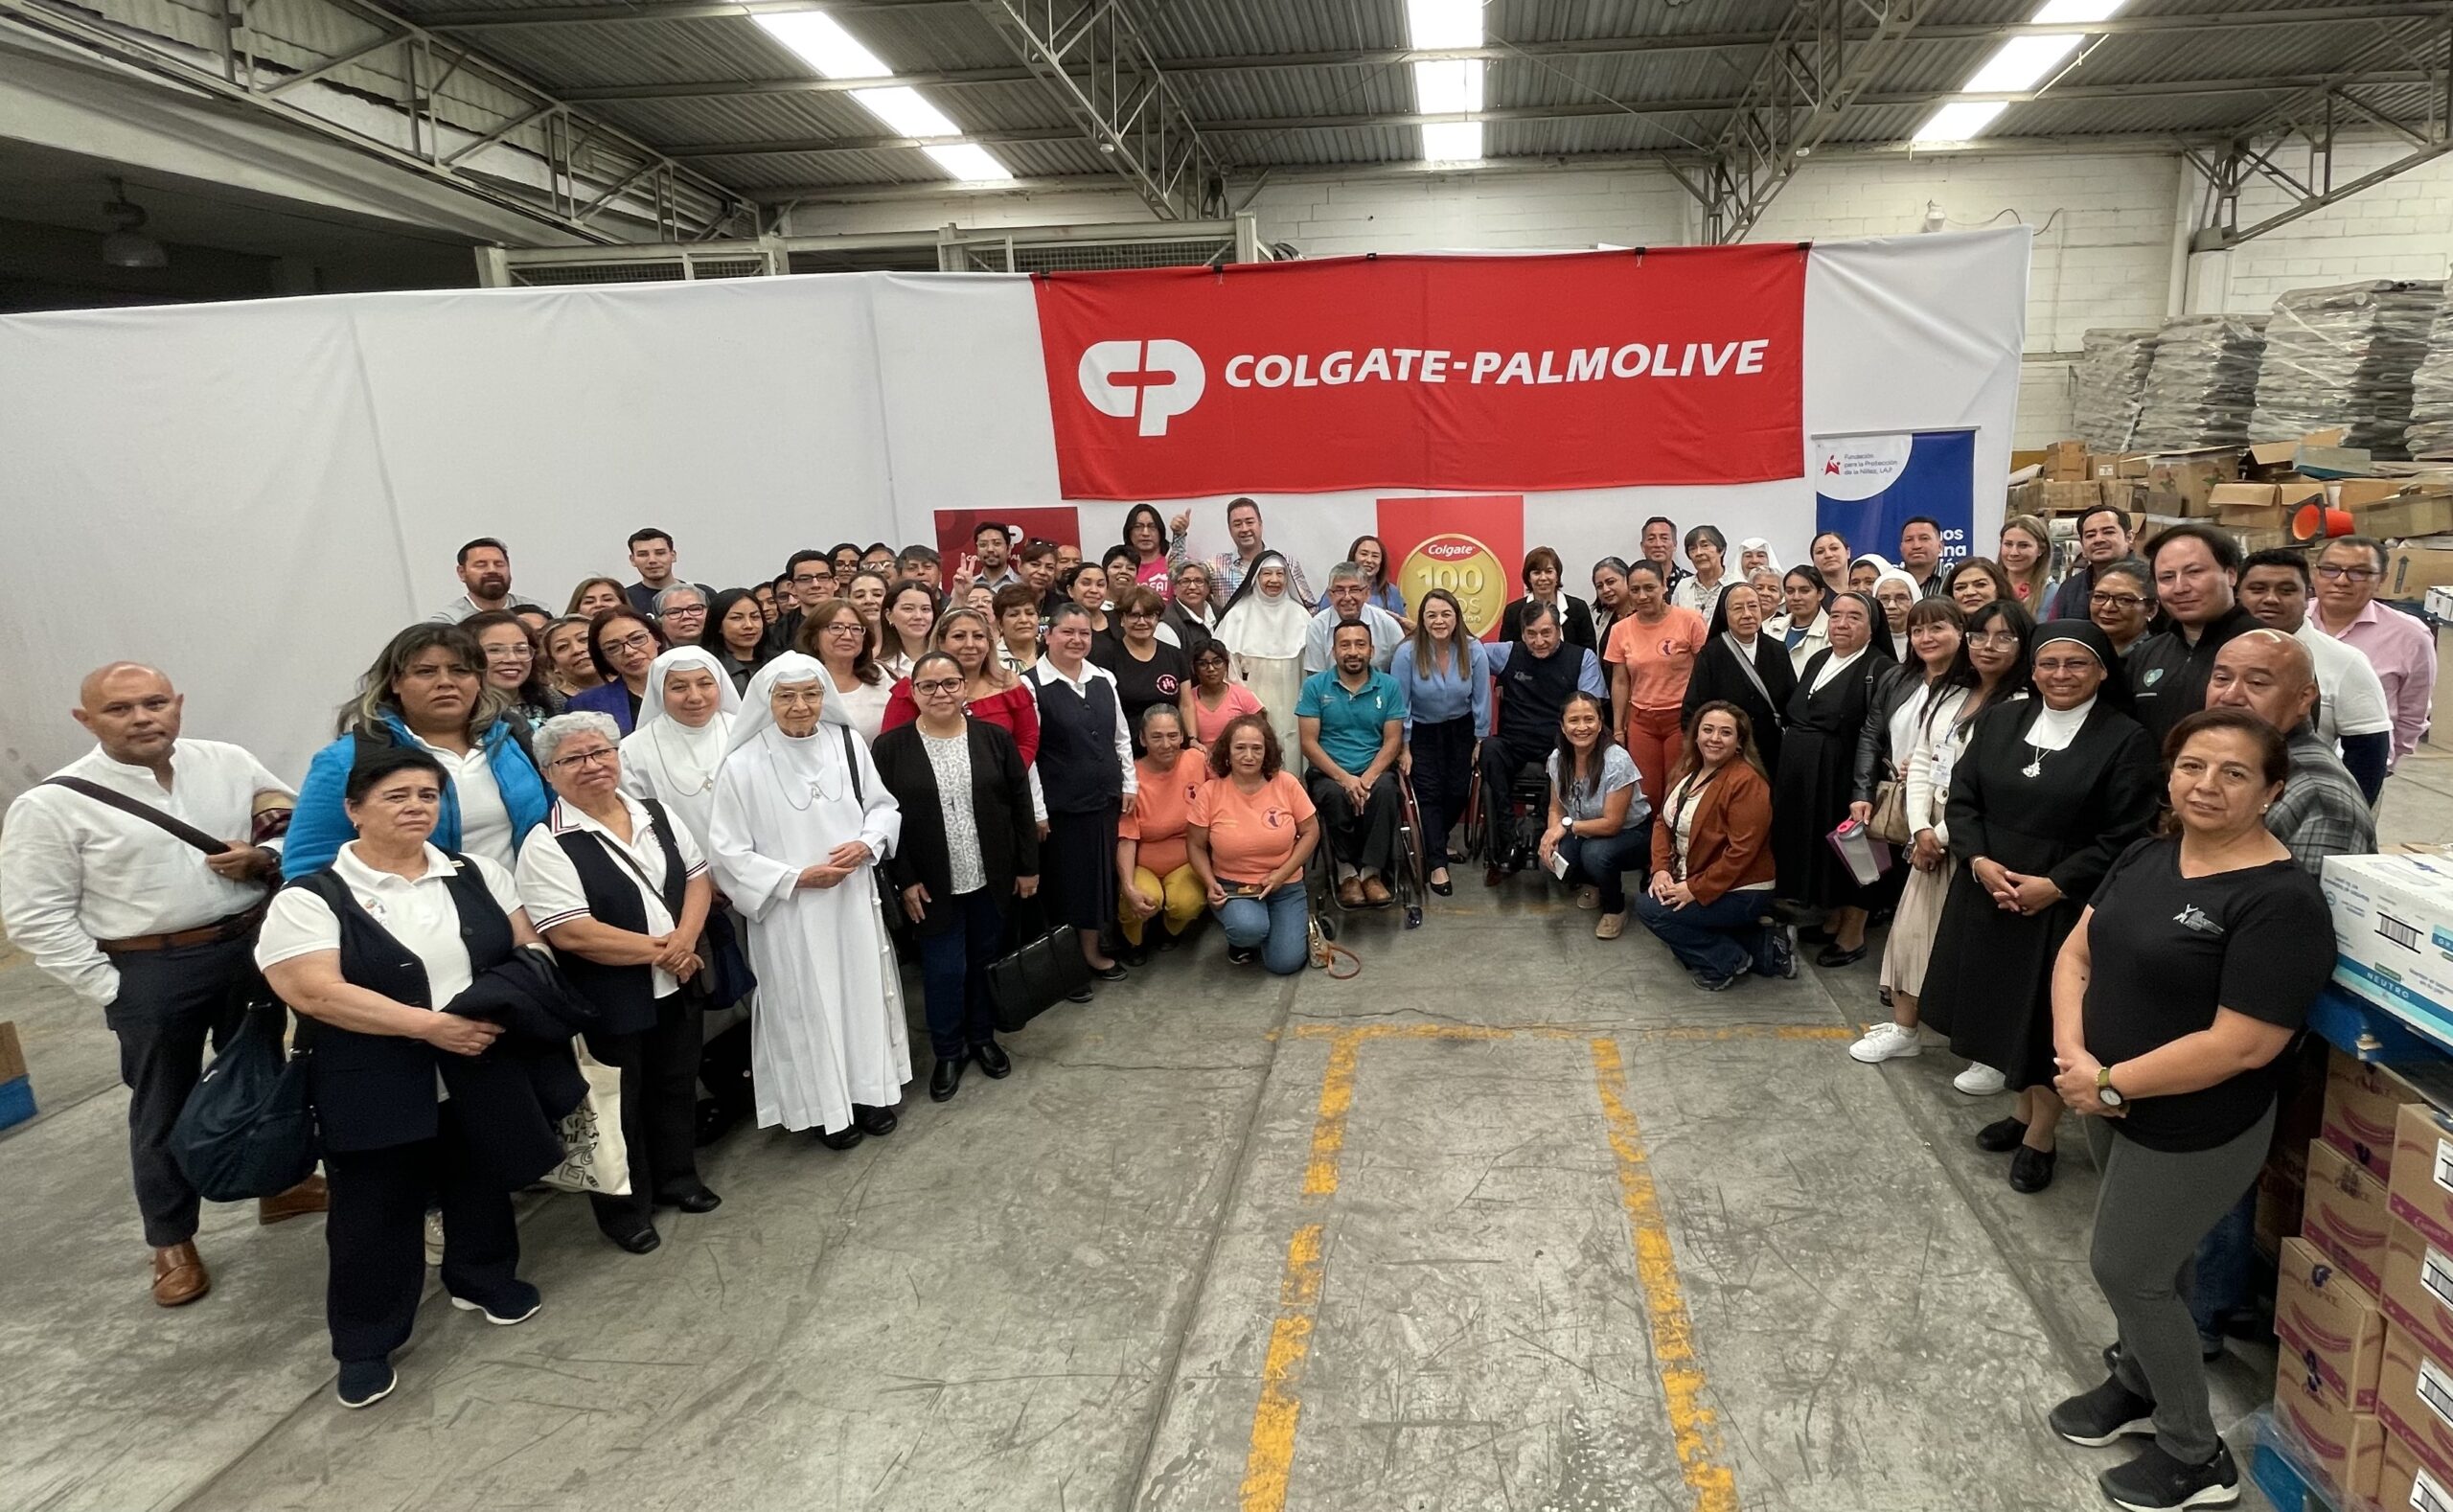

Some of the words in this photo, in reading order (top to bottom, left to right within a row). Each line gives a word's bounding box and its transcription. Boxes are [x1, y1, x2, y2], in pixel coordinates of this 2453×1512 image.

[1226, 338, 1769, 388] COLGATE-PALMOLIVE
[1428, 544, 1474, 557] Colgate
[1417, 564, 1483, 595] 100
[2366, 972, 2410, 998] NEUTRO
